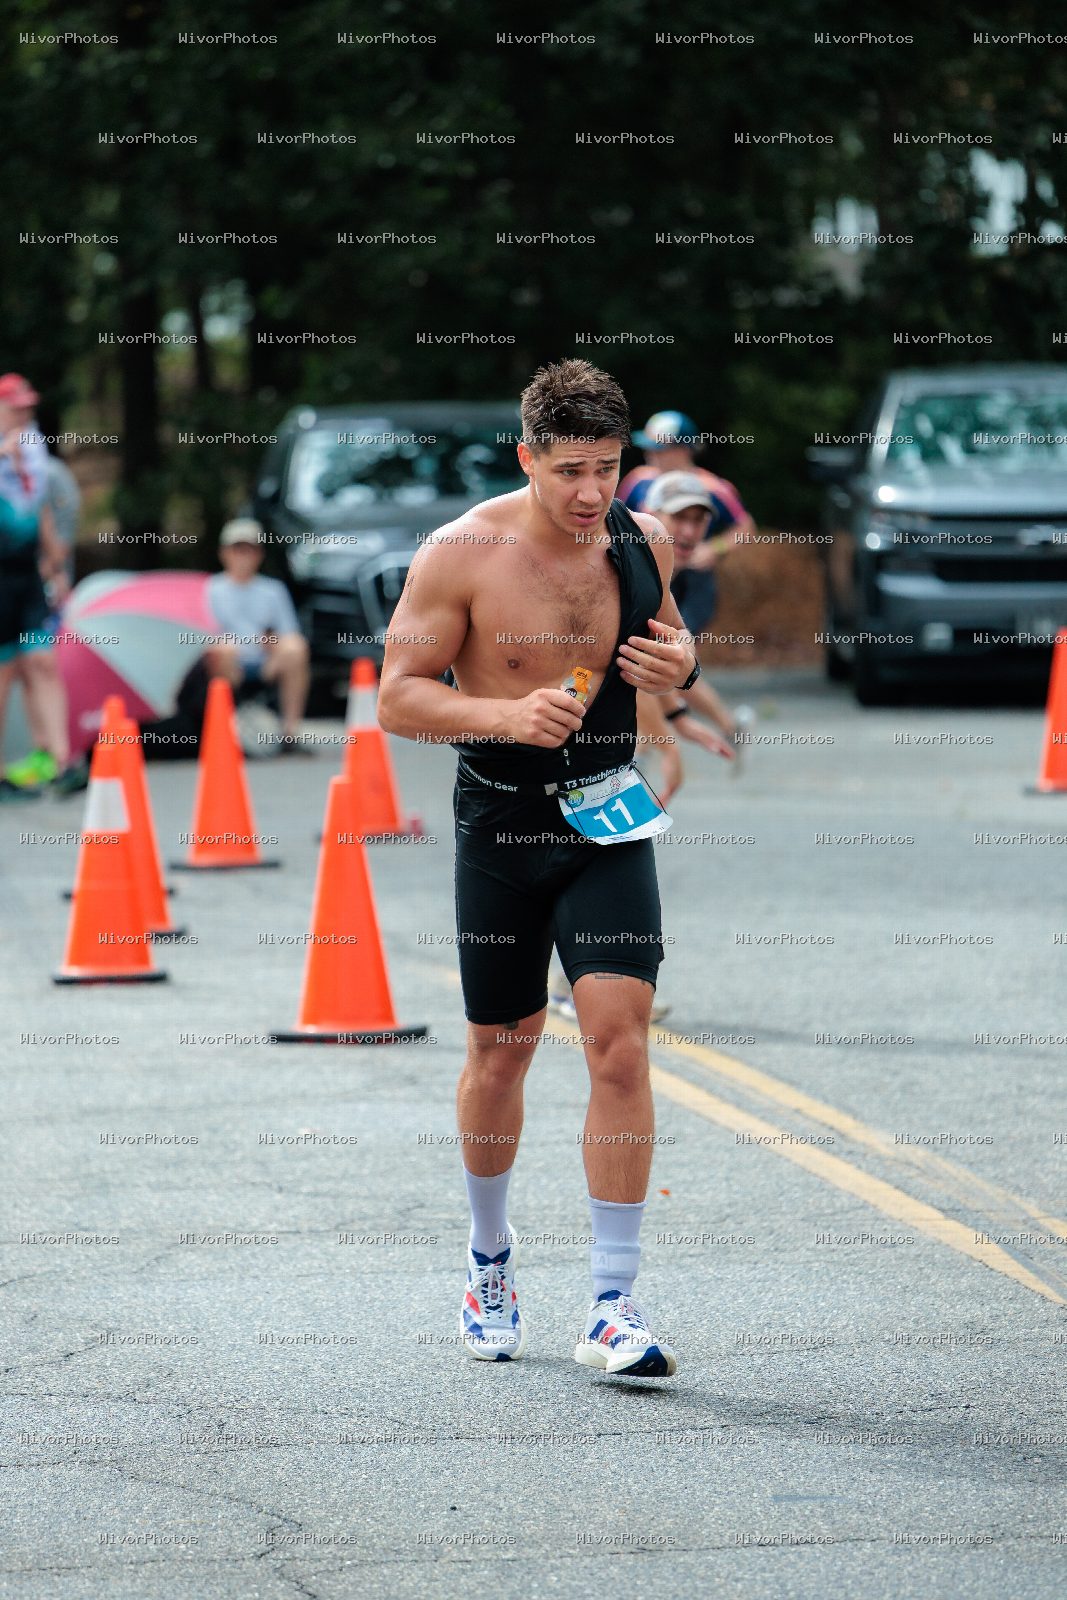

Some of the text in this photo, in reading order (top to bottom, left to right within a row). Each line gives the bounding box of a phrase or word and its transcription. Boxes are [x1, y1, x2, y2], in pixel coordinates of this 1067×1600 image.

[494, 782, 518, 792] Gear
[564, 779, 577, 789] T3
[593, 797, 635, 833] 11
